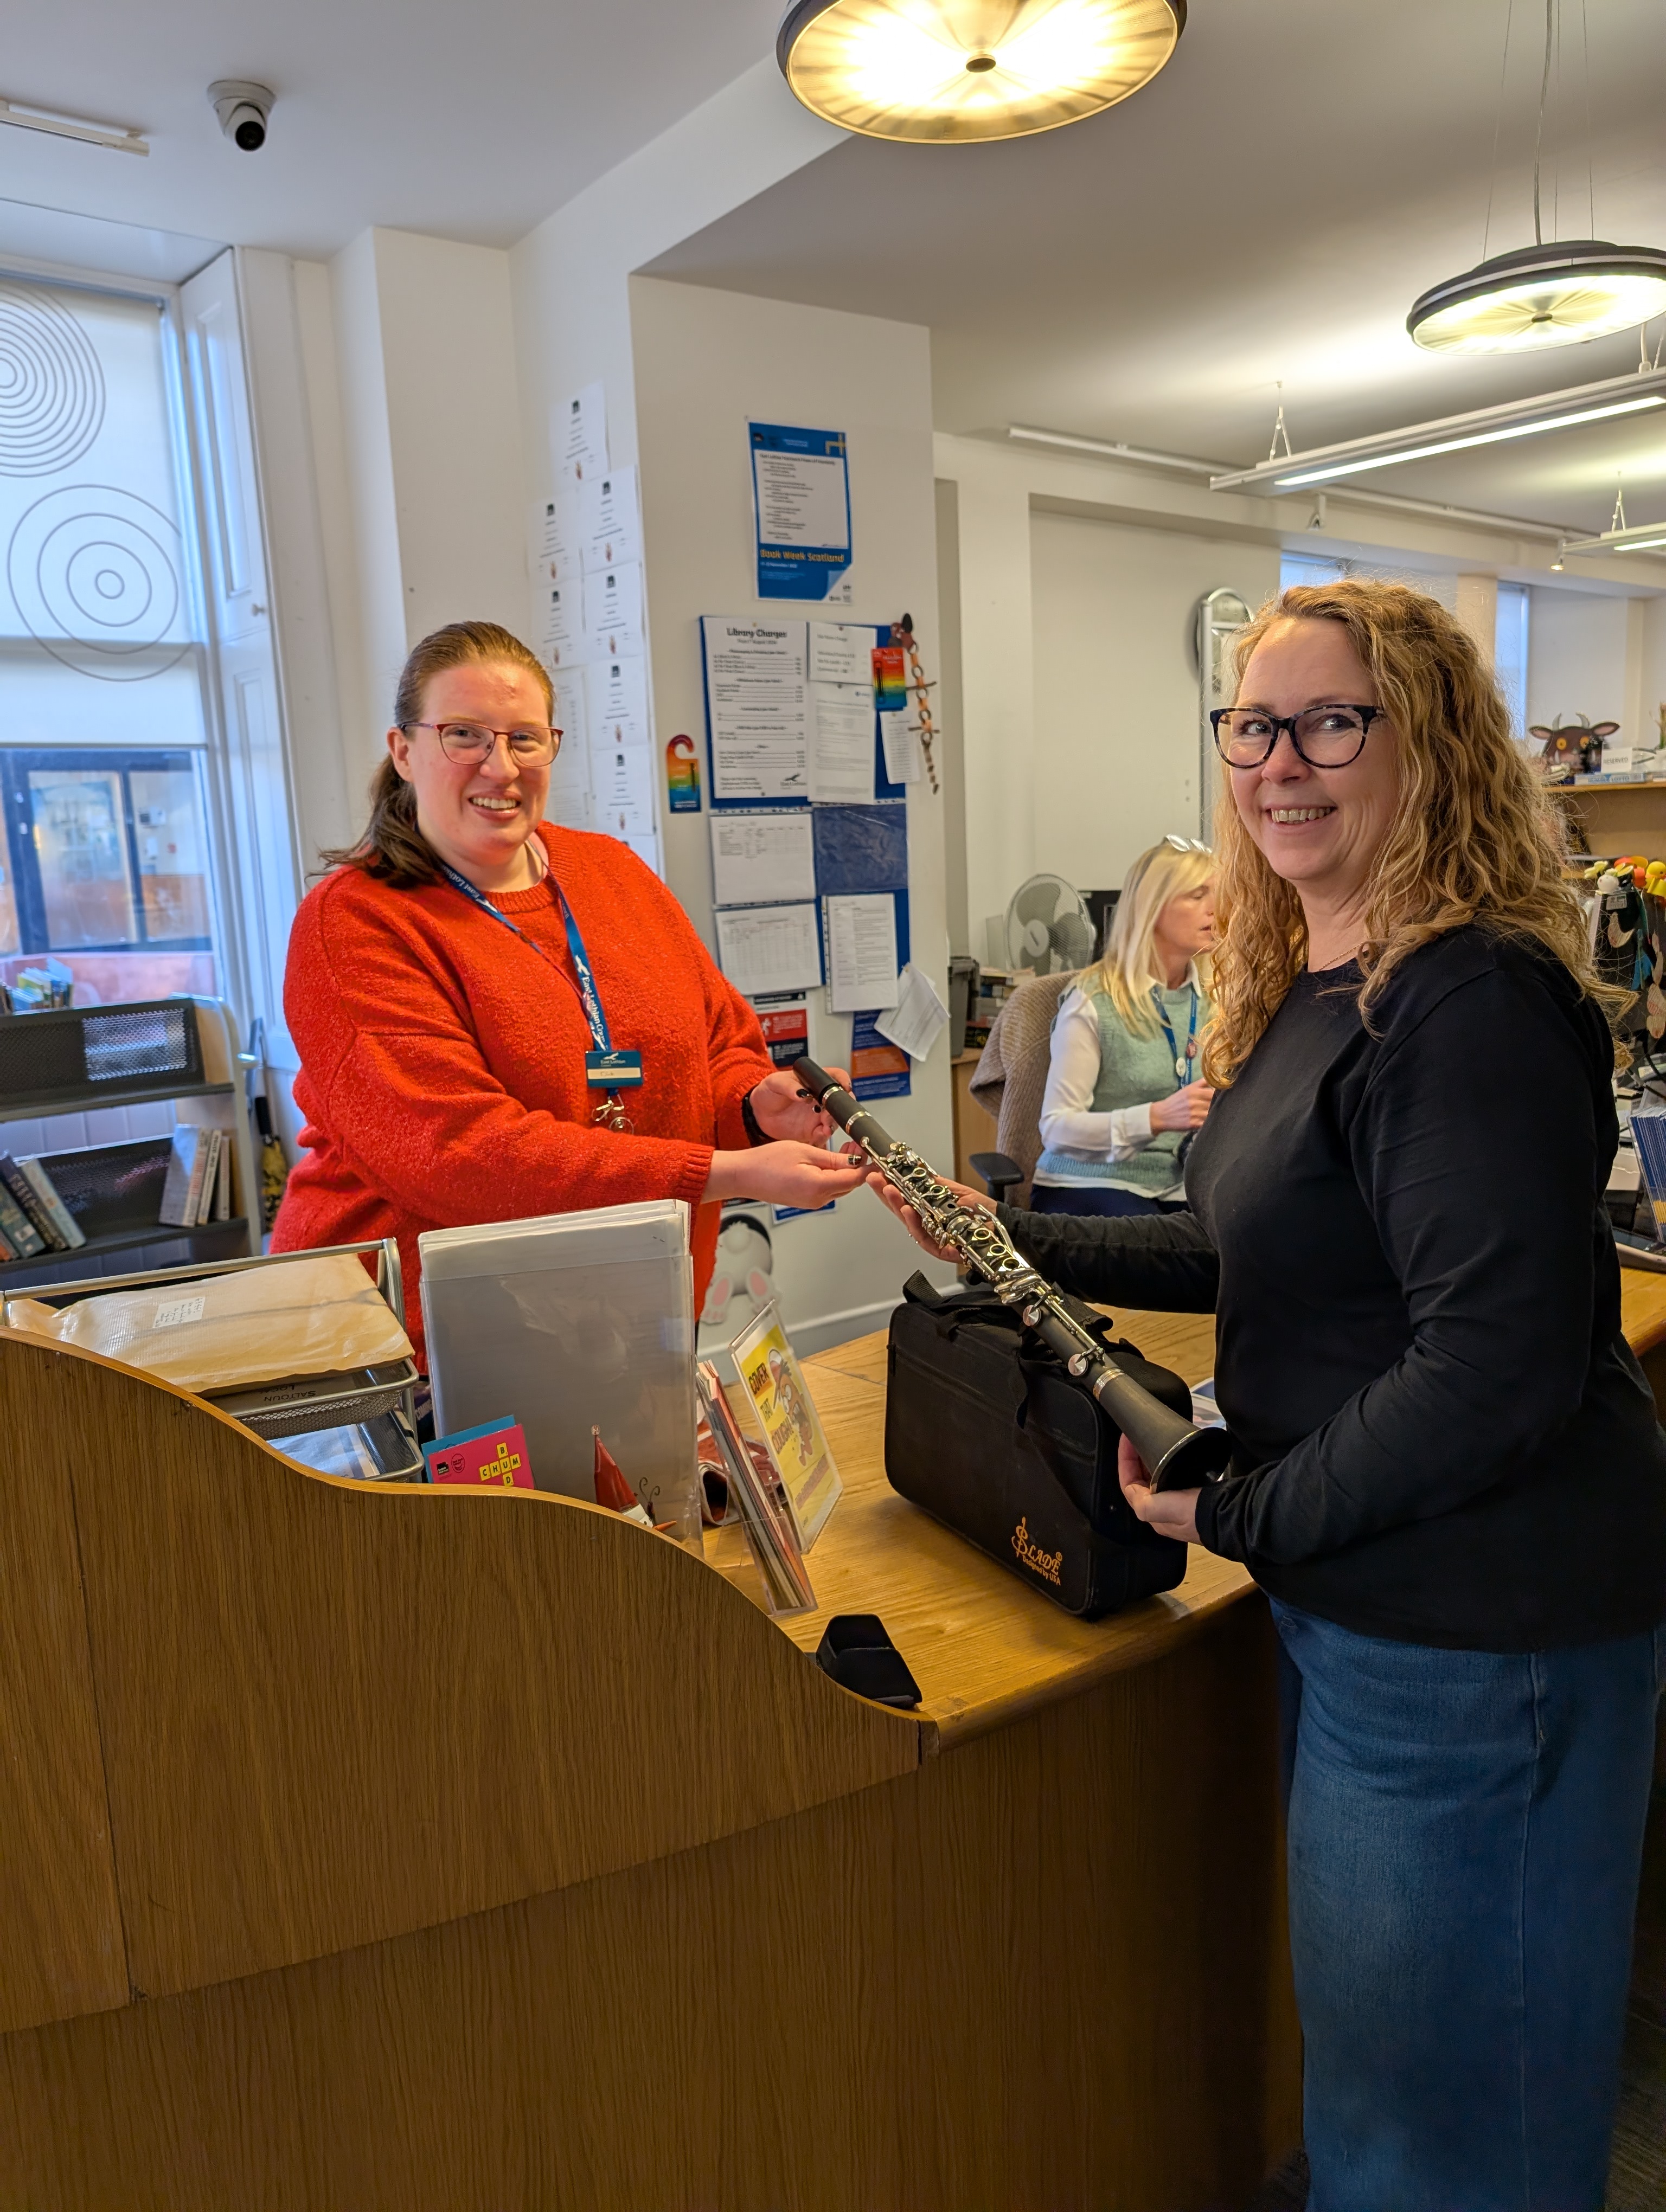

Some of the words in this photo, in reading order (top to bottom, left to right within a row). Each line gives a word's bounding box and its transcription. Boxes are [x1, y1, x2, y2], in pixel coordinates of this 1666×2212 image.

[760, 549, 781, 559] Book
[783, 550, 806, 561] Week
[807, 552, 845, 563] Scotland
[726, 627, 754, 639] Library
[756, 629, 788, 639] Charges
[581, 976, 593, 993] East
[748, 1362, 770, 1395] COVER
[264, 1390, 317, 1402] SALTOUN
[760, 1397, 773, 1423] THAT
